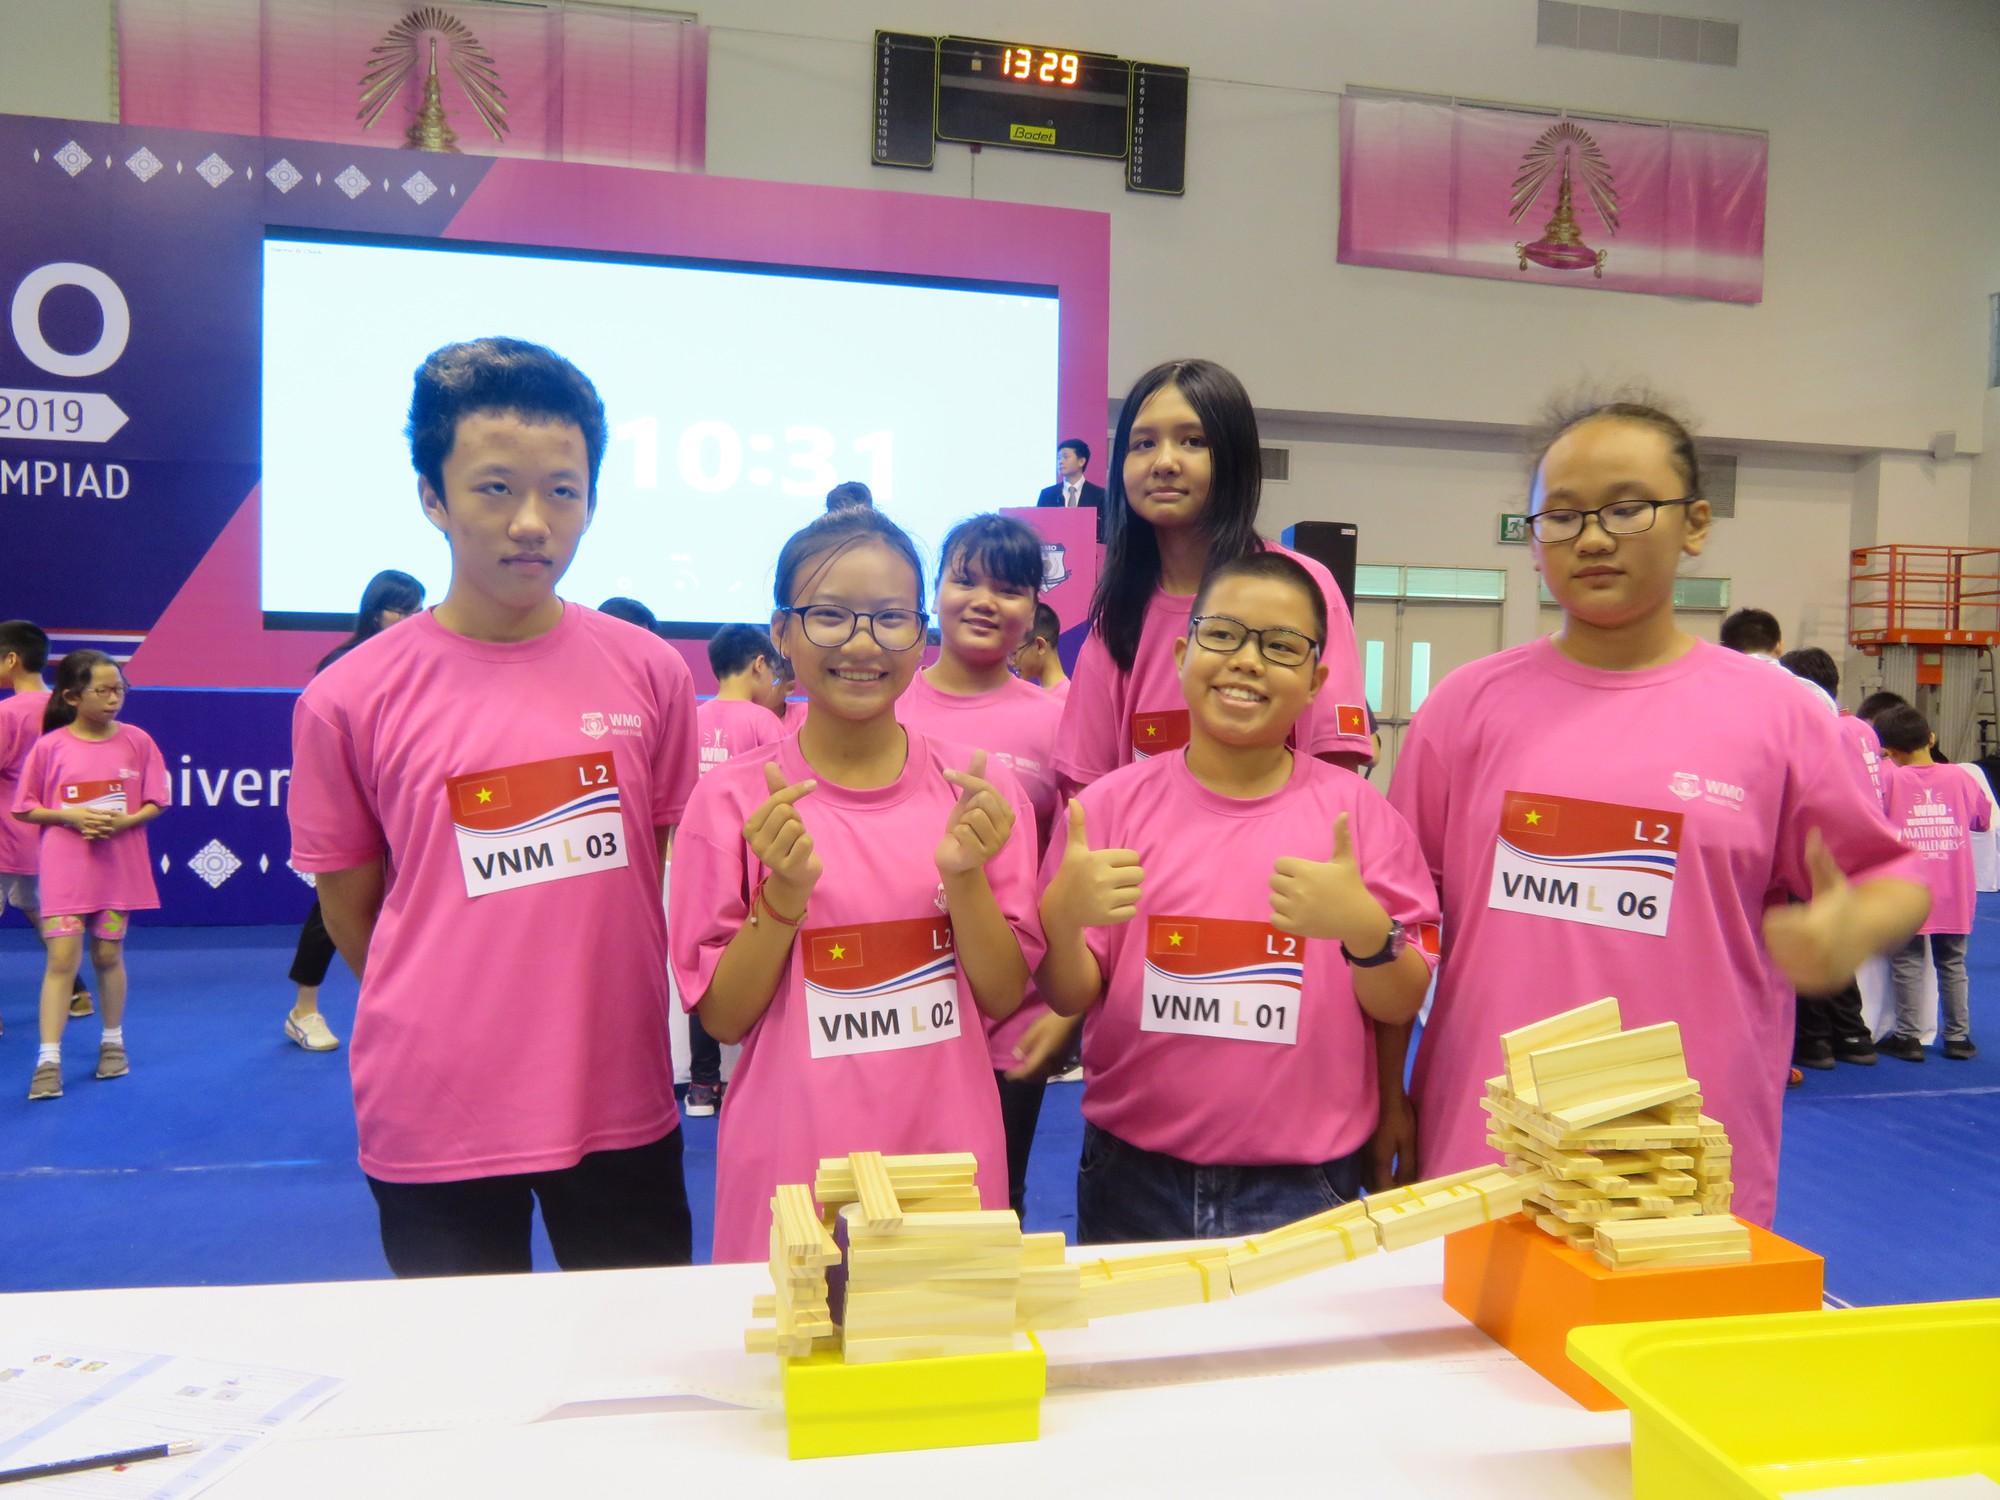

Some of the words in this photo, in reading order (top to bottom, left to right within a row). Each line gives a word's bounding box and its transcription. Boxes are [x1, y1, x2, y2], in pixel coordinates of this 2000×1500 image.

[884, 37, 890, 45] 4
[884, 47, 890, 55] 5
[884, 57, 890, 65] 6
[884, 67, 889, 75] 7
[883, 78, 889, 86] 8
[883, 88, 889, 96] 9
[1139, 87, 1145, 95] 6
[879, 98, 889, 106] 10
[1139, 97, 1145, 105] 7
[879, 108, 887, 116] 11
[1139, 107, 1144, 115] 8
[878, 119, 888, 127] 12
[1138, 117, 1144, 125] 9
[878, 129, 888, 137] 13
[1013, 127, 1053, 142] Bodet
[1135, 126, 1144, 135] 10
[878, 139, 887, 147] 14
[1134, 136, 1142, 144] 11
[878, 149, 887, 157] 15
[1134, 146, 1143, 154] 12
[1134, 156, 1143, 164] 13
[1133, 165, 1142, 174] 14
[1133, 175, 1142, 184] 15
[0, 396, 84, 434] 2019
[615, 417, 893, 501] 10:31
[0, 460, 131, 500] MPIAD
[608, 713, 642, 728] WMO
[1704, 779, 1745, 802] WMO
[1912, 803, 1947, 818] WMO
[472, 842, 554, 880] VNM
[563, 838, 582, 863] L
[586, 832, 617, 859] 03
[1502, 871, 1578, 908] VNM
[1586, 885, 1604, 912] L
[1617, 891, 1658, 920] 06
[1151, 994, 1221, 1024] VNM
[1233, 1000, 1249, 1027] L
[1255, 1004, 1286, 1030] 01
[818, 1008, 901, 1042] VNM
[911, 1005, 926, 1033] L
[930, 1000, 954, 1028] 02
